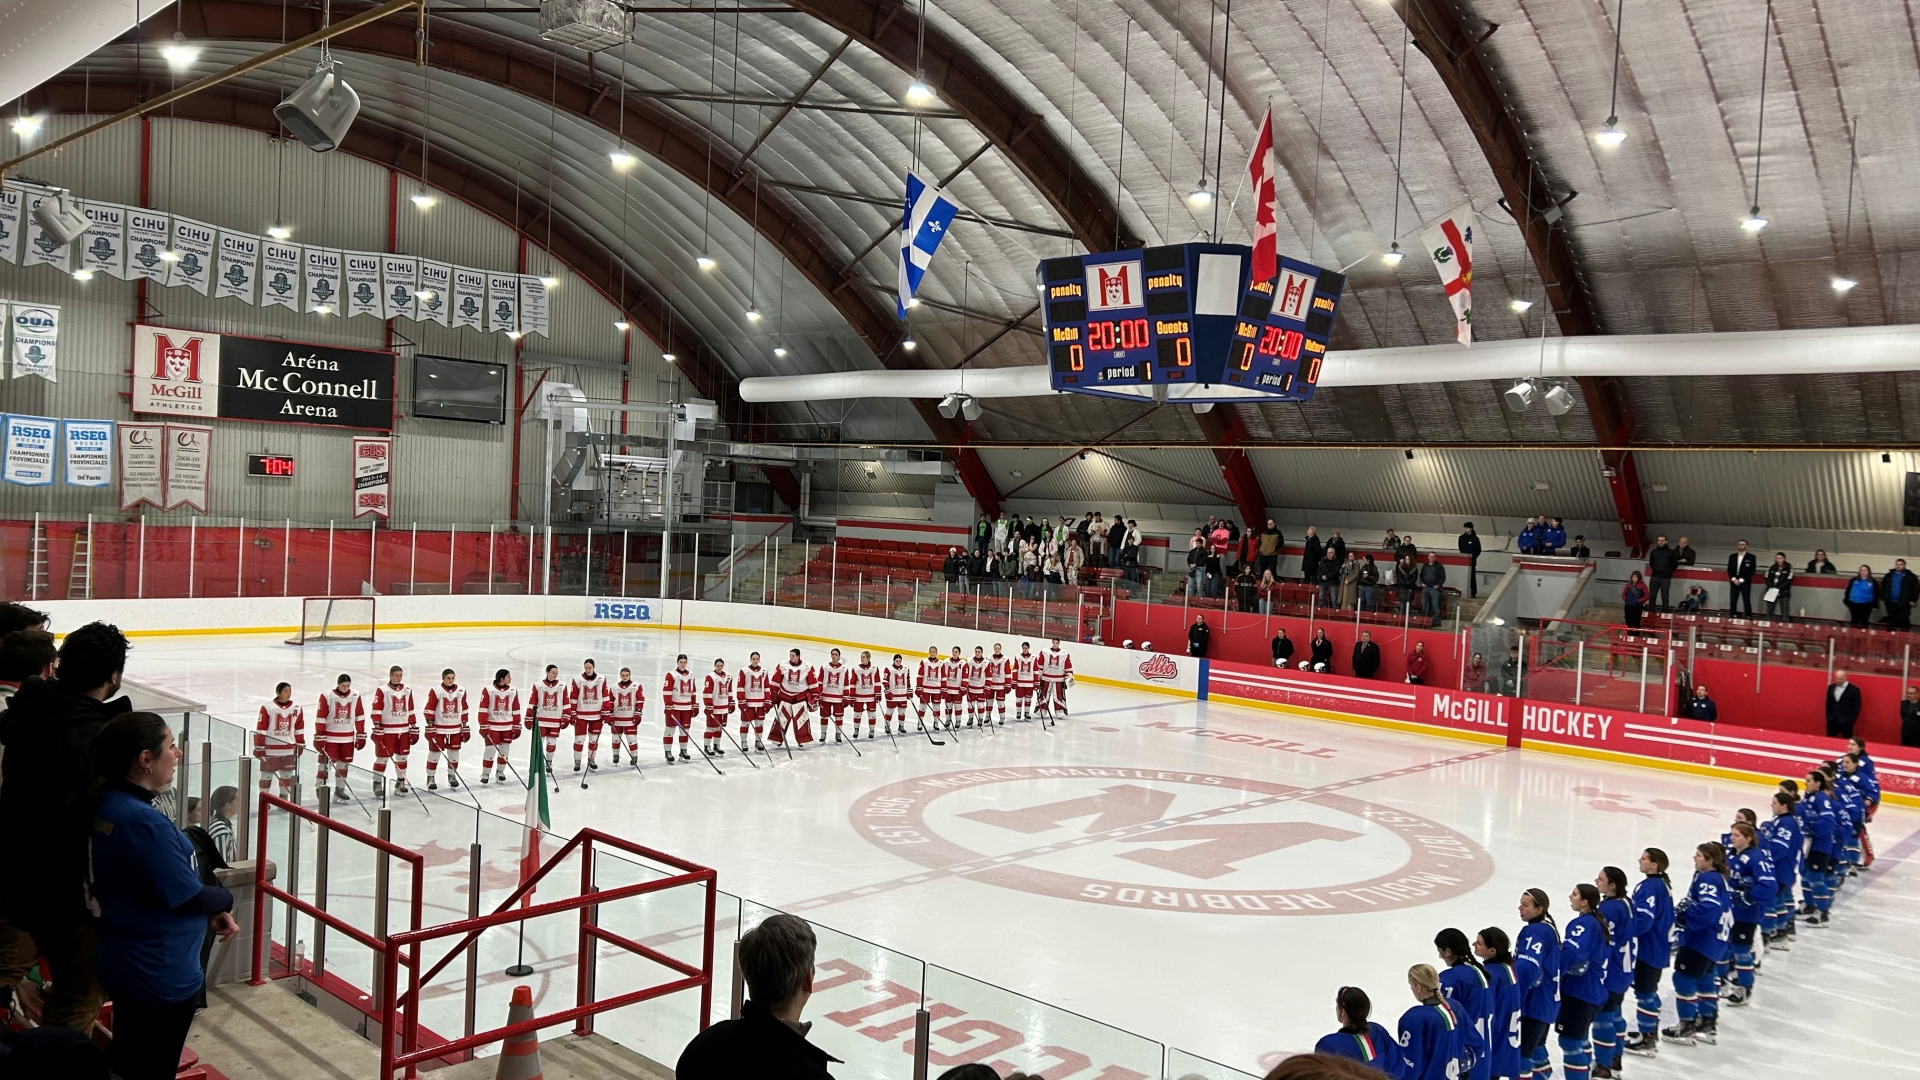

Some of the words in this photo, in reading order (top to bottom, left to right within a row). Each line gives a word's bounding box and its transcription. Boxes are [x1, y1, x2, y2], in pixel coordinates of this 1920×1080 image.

[85, 209, 118, 223] CIHU
[132, 216, 165, 231] CIHU
[178, 226, 210, 242] CIHU
[174, 243, 210, 257] CHAMPIONS
[224, 238, 254, 253] CIHU
[267, 247, 296, 260] CIHU
[310, 254, 337, 266] CIHU
[220, 255, 255, 268] CHAMPIONS
[349, 259, 376, 270] CIHU
[387, 262, 412, 273] CIHU
[264, 264, 297, 275] CHAMPIONS
[423, 267, 447, 280] CIHU
[458, 274, 482, 286] CIHU
[492, 279, 515, 289] CIHU
[1148, 273, 1183, 290] penalty
[1051, 283, 1081, 299] penalty
[1313, 296, 1335, 313] penalty
[16, 316, 54, 327] OUA
[1156, 321, 1188, 334] Guests
[1053, 326, 1079, 341] McGill
[1088, 318, 1150, 351] 20:00
[1238, 322, 1258, 338] McGill
[15, 337, 55, 347] CHAMPIONS
[1259, 325, 1304, 361] 20:00
[1070, 344, 1084, 371] 0
[1176, 337, 1192, 366] 0
[1240, 343, 1255, 371] 0
[281, 350, 340, 372] Aréna
[1107, 365, 1135, 380] period
[1146, 362, 1152, 380] 1
[1308, 358, 1321, 384] 0
[1261, 373, 1282, 387] period
[1286, 374, 1293, 391] 1
[151, 383, 202, 399] McGill
[150, 401, 203, 411] ATHLETICS
[279, 398, 338, 418] Arena
[11, 426, 51, 439] RSEQ
[69, 430, 107, 441] RSEQ
[9, 450, 50, 458] CHAMPIONNES
[359, 445, 386, 456] CIS
[9, 456, 49, 464] PROVINCIALES
[357, 477, 387, 489] CHAMPIONS
[594, 603, 651, 621] RSEQ
[1432, 693, 1508, 728] McGILL
[1523, 704, 1613, 741] HOCKEY
[1132, 721, 1338, 759] McGILL
[1036, 767, 1225, 786] MARTLETS
[1777, 827, 1792, 840] 23
[1079, 883, 1337, 911] REDBIRDS
[1699, 882, 1717, 897] 22
[1646, 896, 1656, 908] 4
[1571, 925, 1585, 937] 3
[1525, 936, 1543, 955] 14
